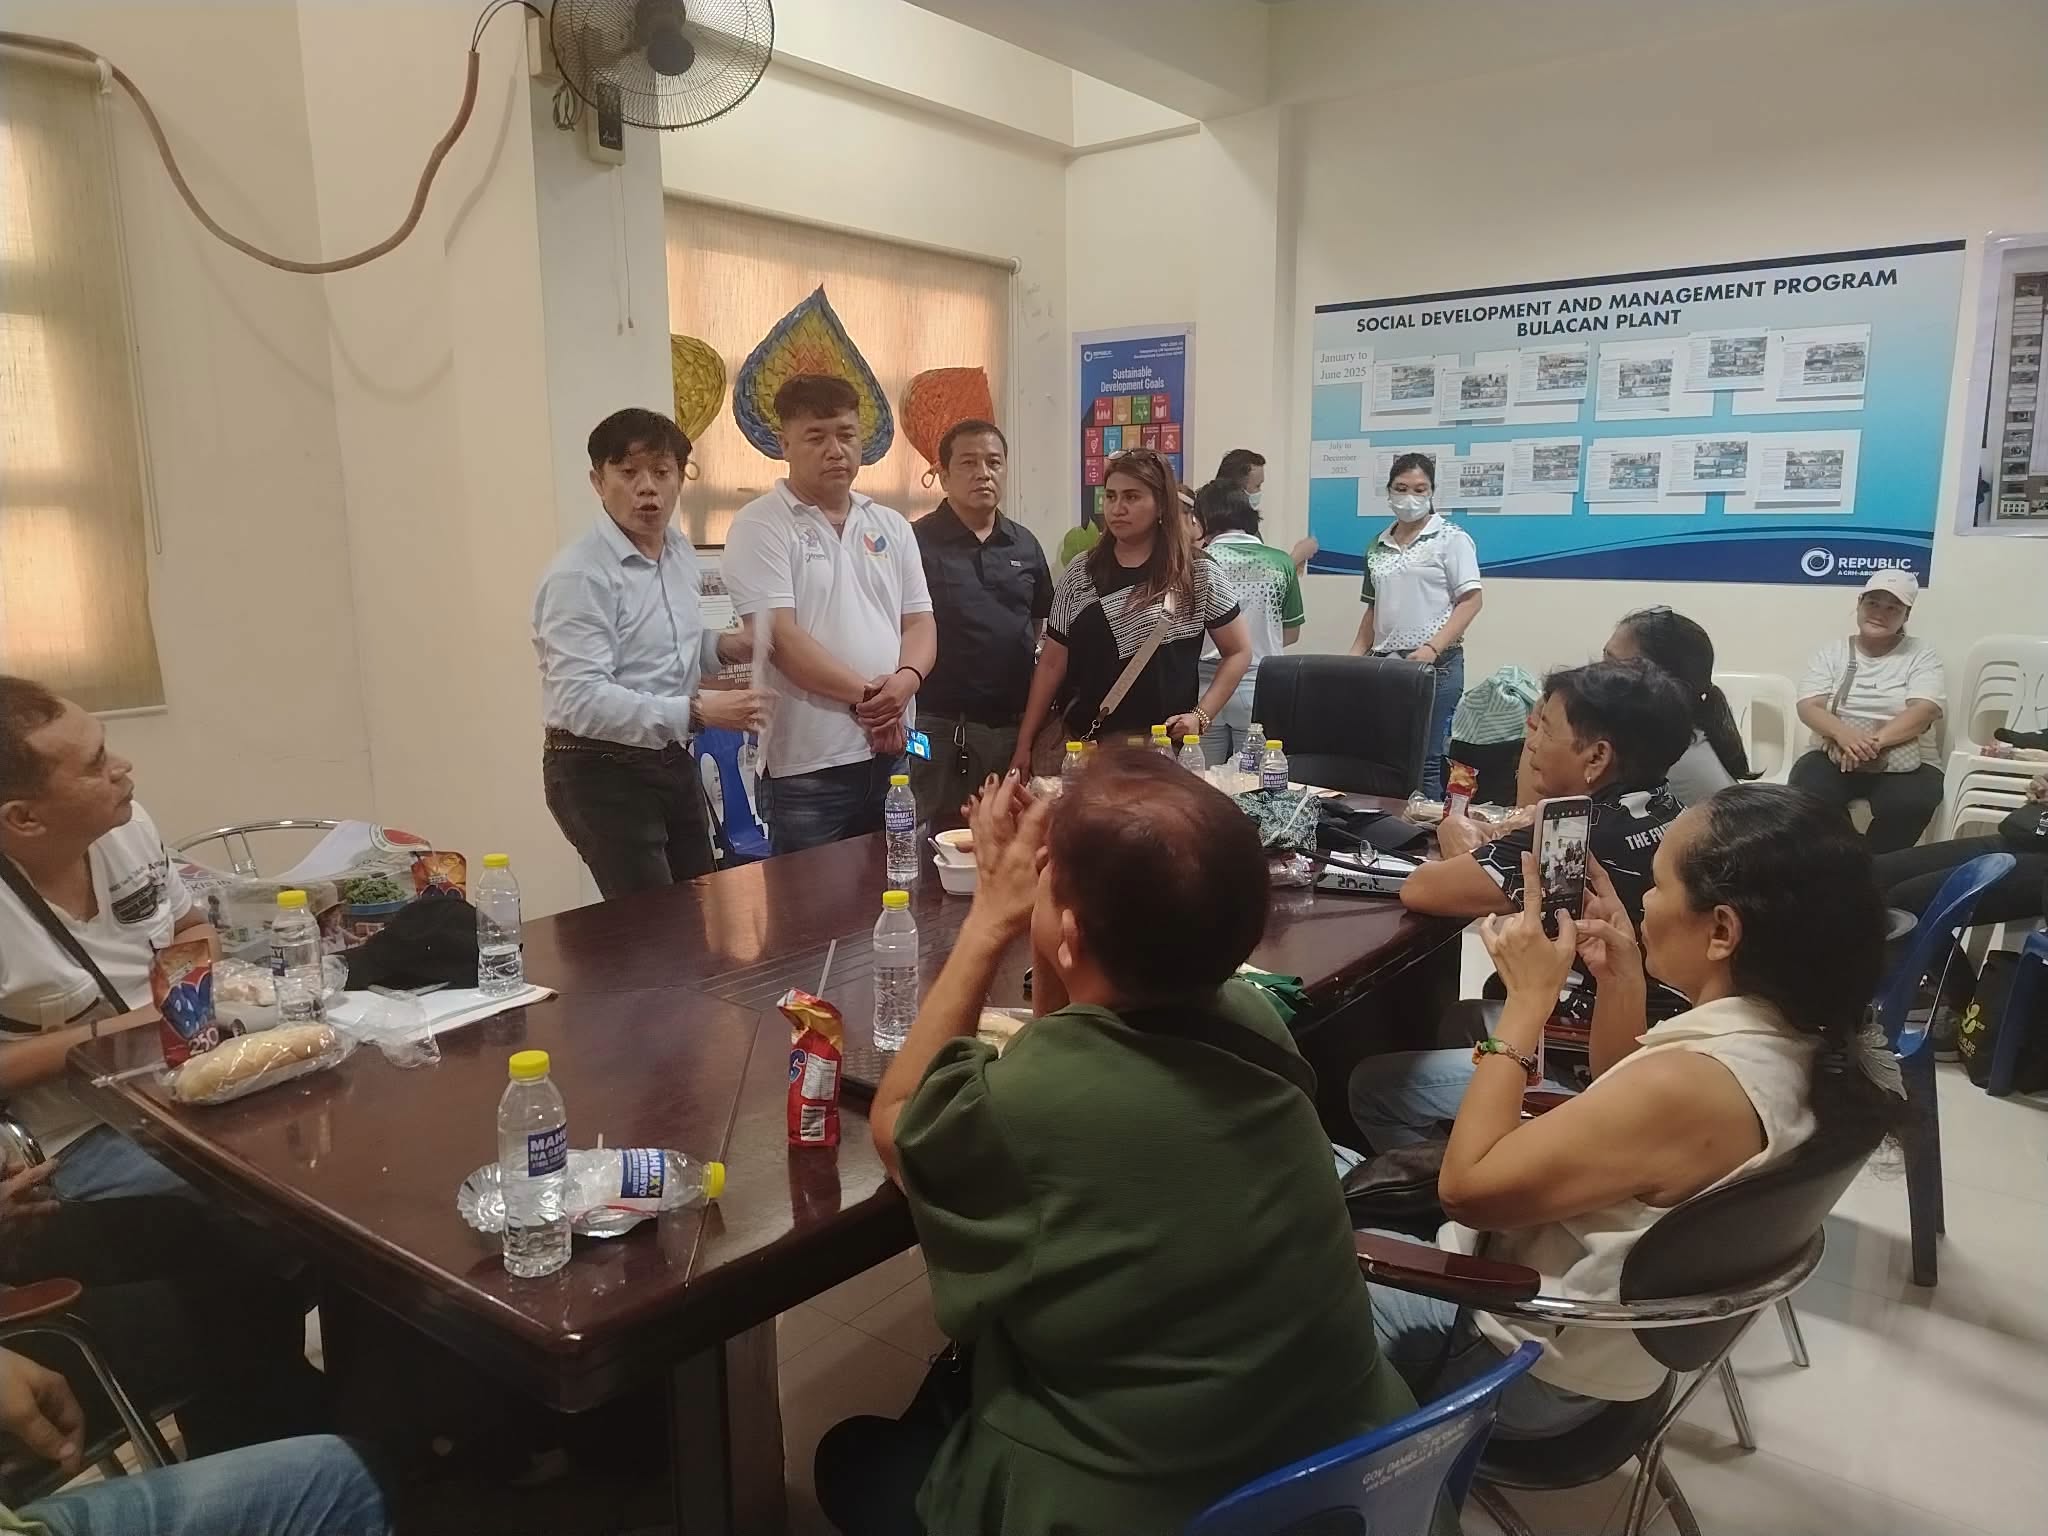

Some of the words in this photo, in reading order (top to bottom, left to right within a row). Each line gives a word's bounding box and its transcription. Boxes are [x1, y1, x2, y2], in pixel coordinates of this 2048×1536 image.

[1357, 314, 1415, 332] SOCIAL
[1421, 300, 1552, 327] DEVELOPMENT
[1557, 296, 1602, 314] AND
[1609, 280, 1767, 310] MANAGEMENT
[1773, 269, 1898, 296] PROGRAM
[1517, 315, 1608, 337] BULACAN
[1616, 309, 1682, 329] PLANT
[1320, 352, 1355, 364] January
[1358, 351, 1368, 360] to
[1112, 365, 1153, 380] Sustainable
[1320, 369, 1342, 380] June
[1343, 366, 1367, 378] 2025
[1100, 379, 1144, 393] Development
[1144, 377, 1165, 389] Goals
[1322, 454, 1358, 463] December
[1838, 557, 1912, 570] REPUBLIC
[1625, 831, 1651, 850] THE
[189, 1027, 219, 1056] 250
